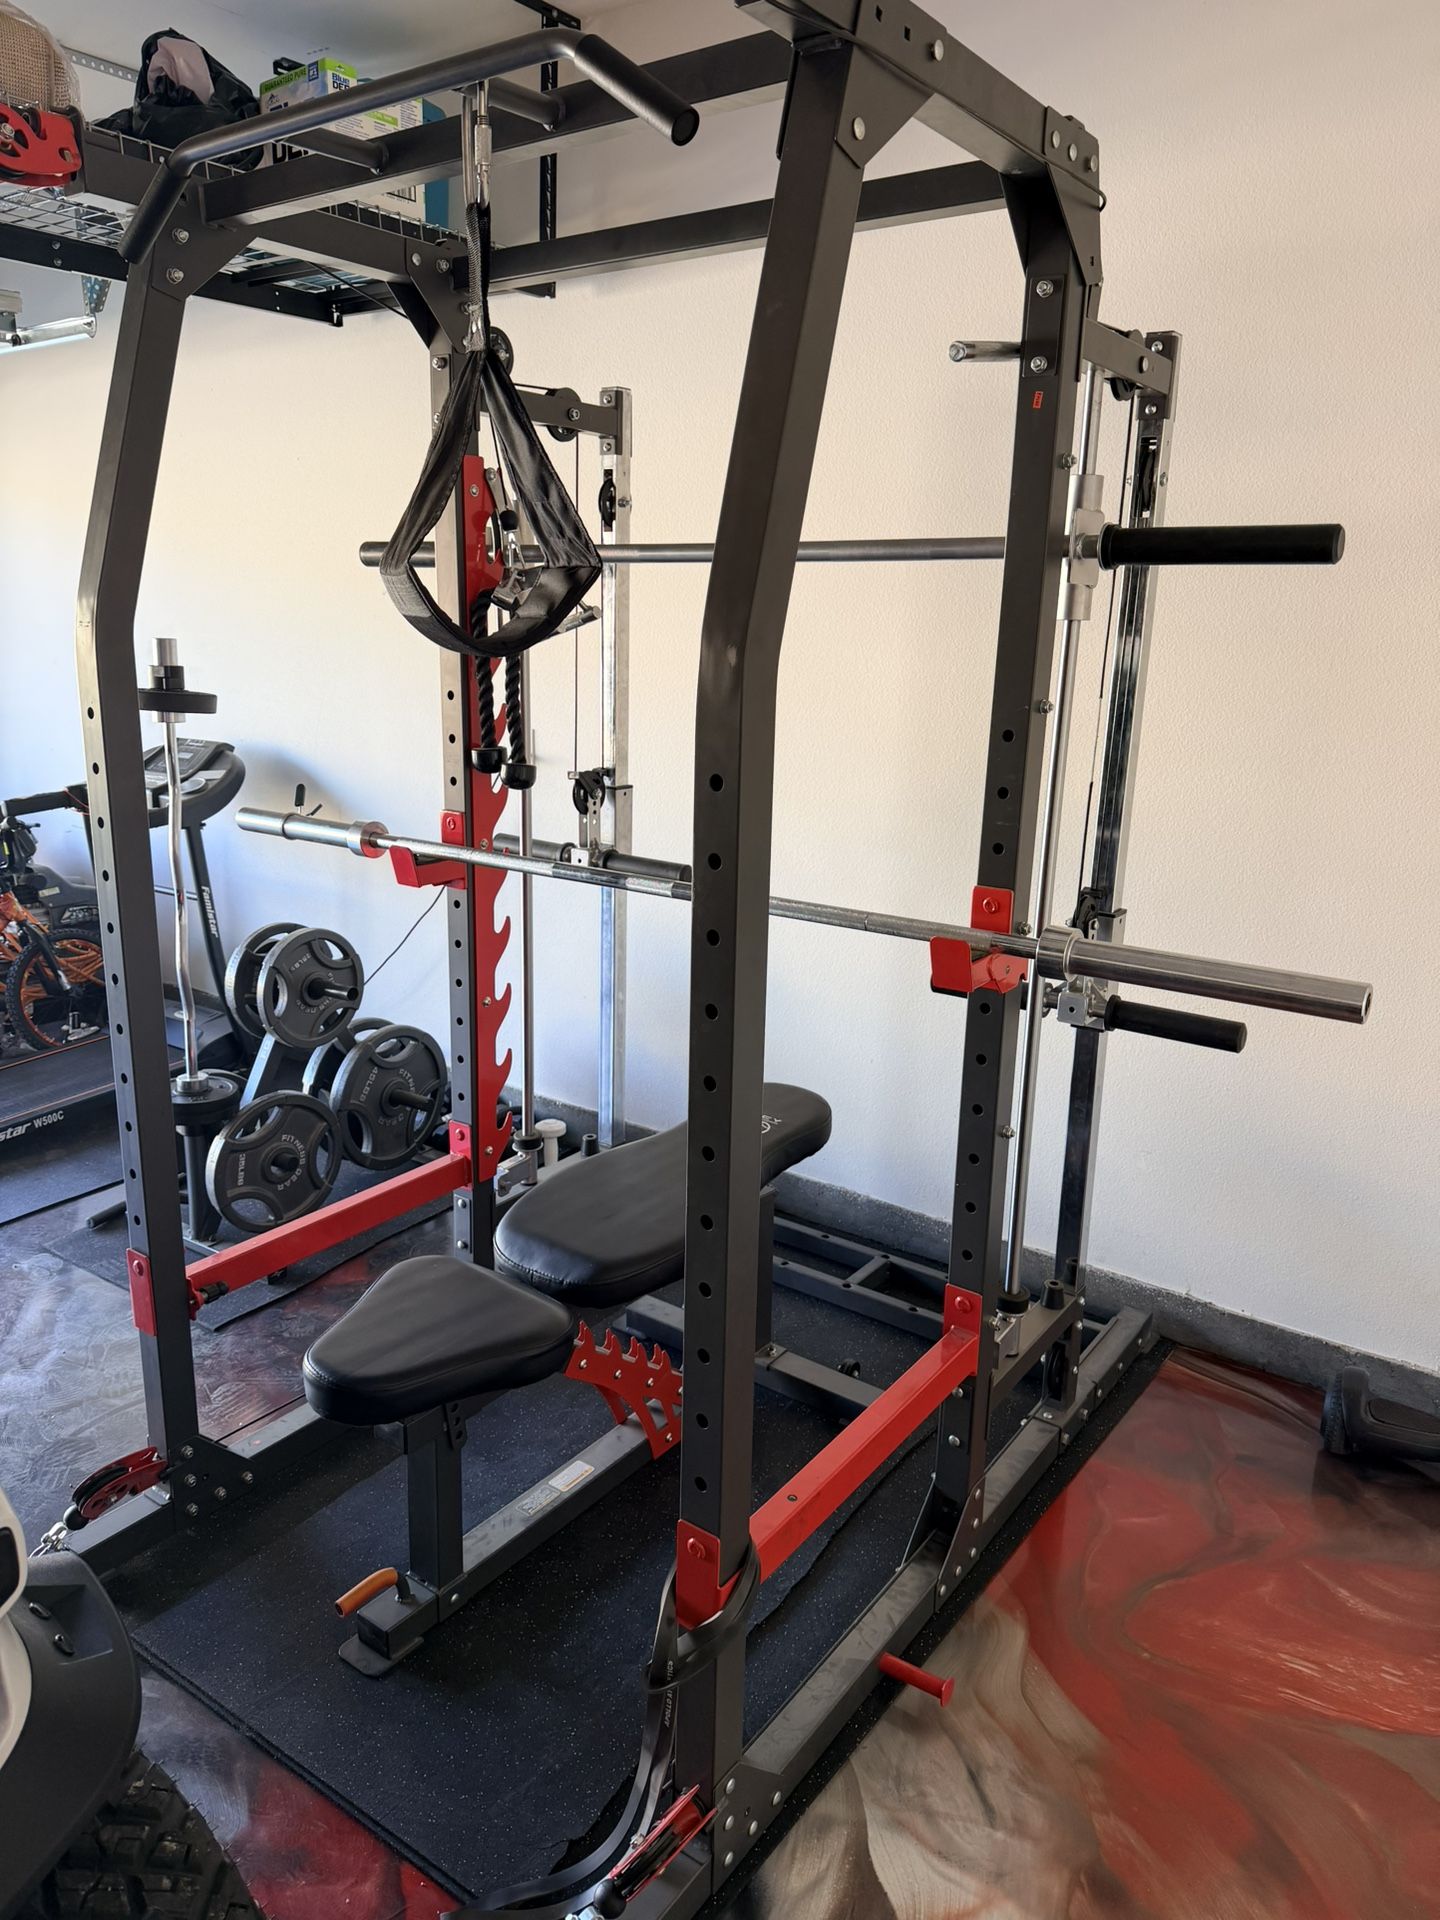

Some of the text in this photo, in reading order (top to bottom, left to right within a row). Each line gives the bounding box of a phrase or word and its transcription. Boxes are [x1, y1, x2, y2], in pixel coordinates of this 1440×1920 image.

[201, 885, 219, 938] Famistar
[33, 1110, 64, 1128] W500C
[281, 1134, 306, 1165] FITNESS
